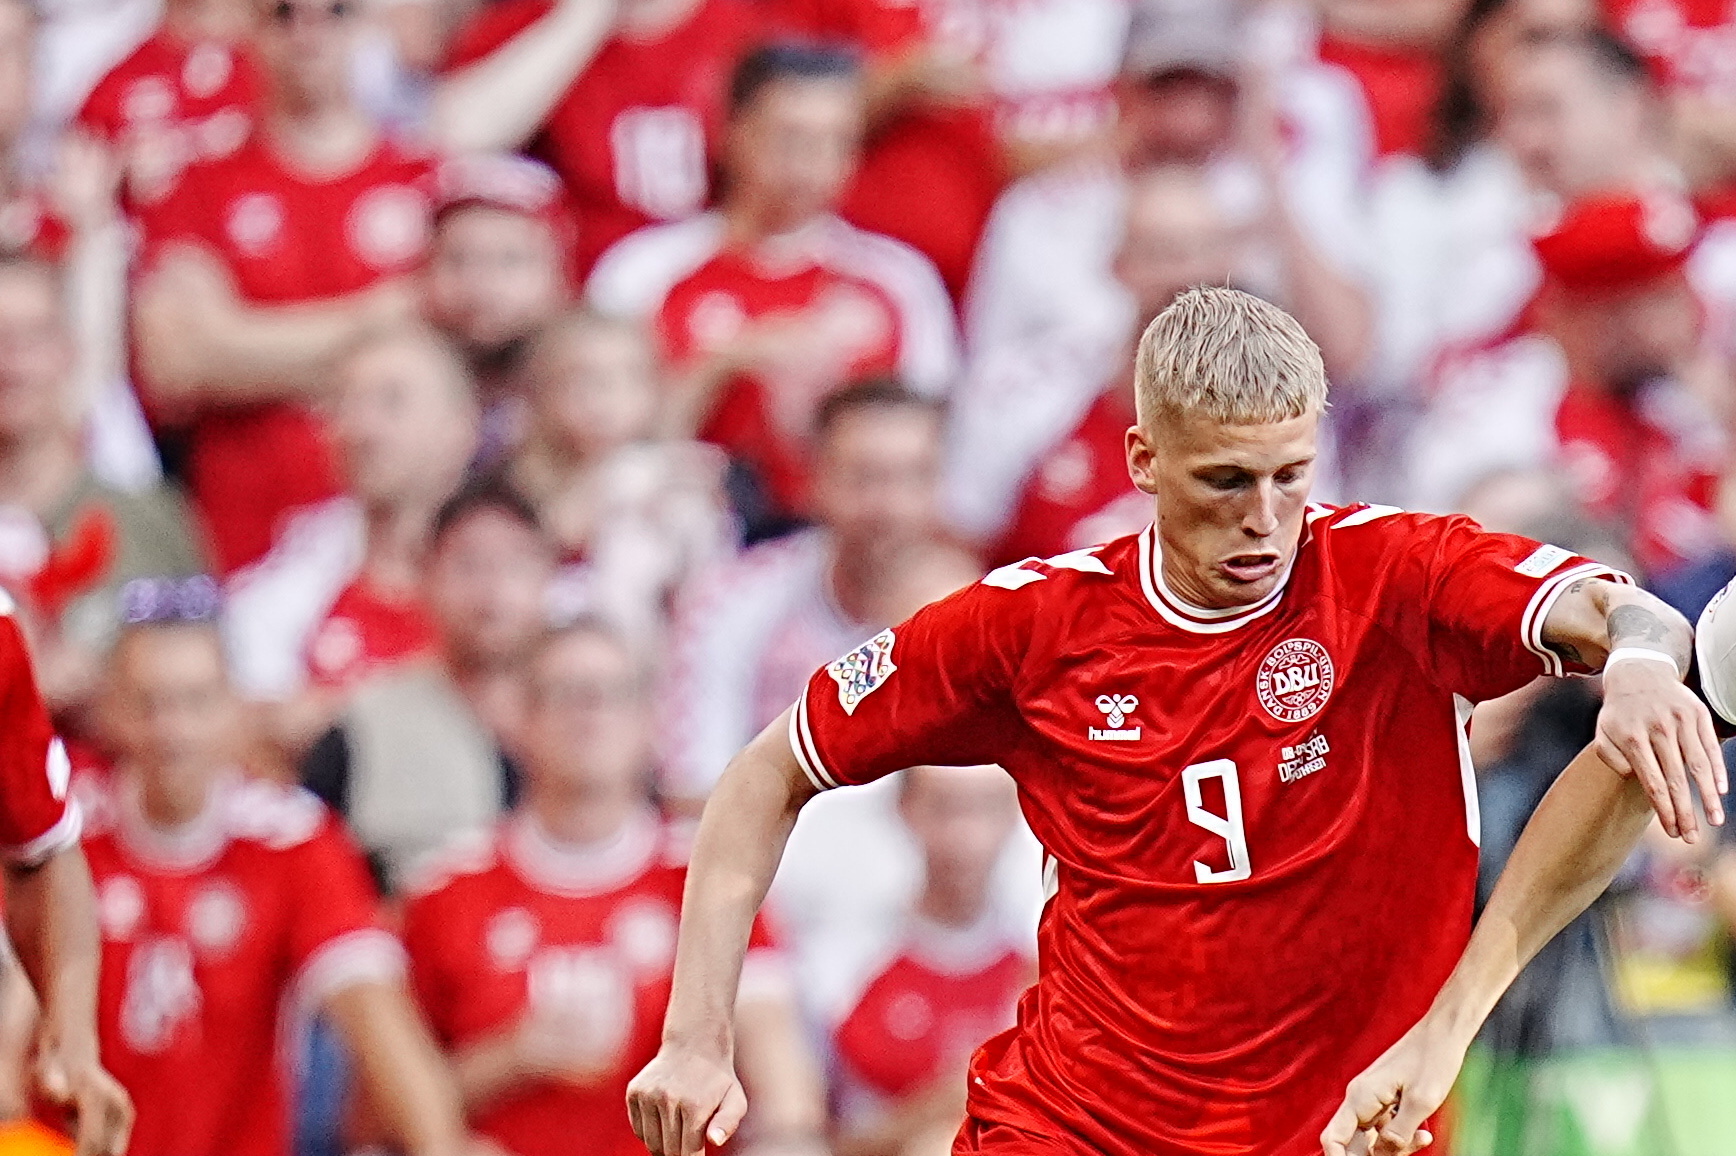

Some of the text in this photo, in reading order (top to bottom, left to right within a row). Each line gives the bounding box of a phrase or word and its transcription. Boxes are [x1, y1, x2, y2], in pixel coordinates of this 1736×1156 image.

[1272, 663, 1321, 696] DBU
[1088, 726, 1142, 741] hummel
[1181, 758, 1252, 884] 9
